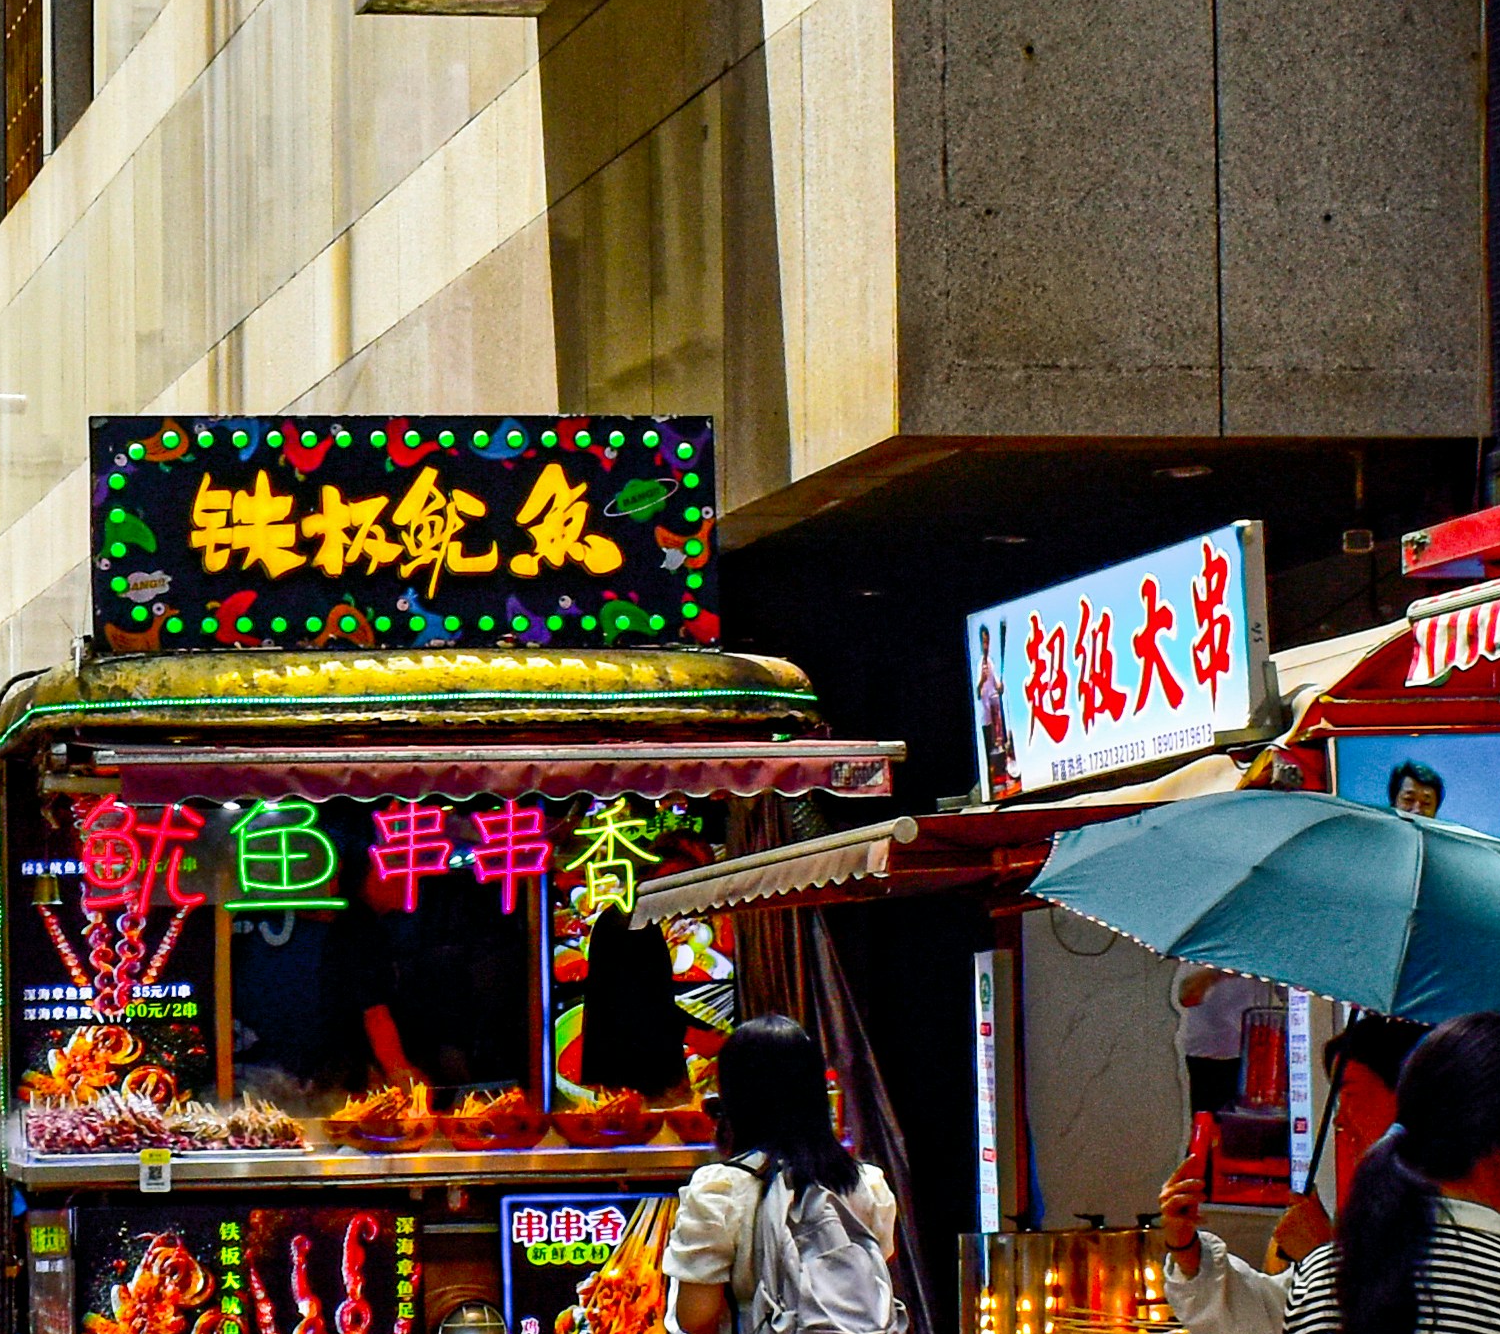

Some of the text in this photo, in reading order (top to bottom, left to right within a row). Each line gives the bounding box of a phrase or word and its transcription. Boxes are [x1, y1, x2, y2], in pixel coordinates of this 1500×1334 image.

[187, 462, 624, 600] 铁板鱿鱼
[1025, 542, 1233, 746] 超级大串
[81, 794, 663, 914] 鱿鱼串串香
[125, 1001, 199, 1018] 60元/2串
[131, 984, 192, 999] 35元/1串
[512, 1207, 627, 1246] 串串香
[530, 1245, 609, 1263] 新鲜食材
[395, 1216, 416, 1320] 深海章鱼足
